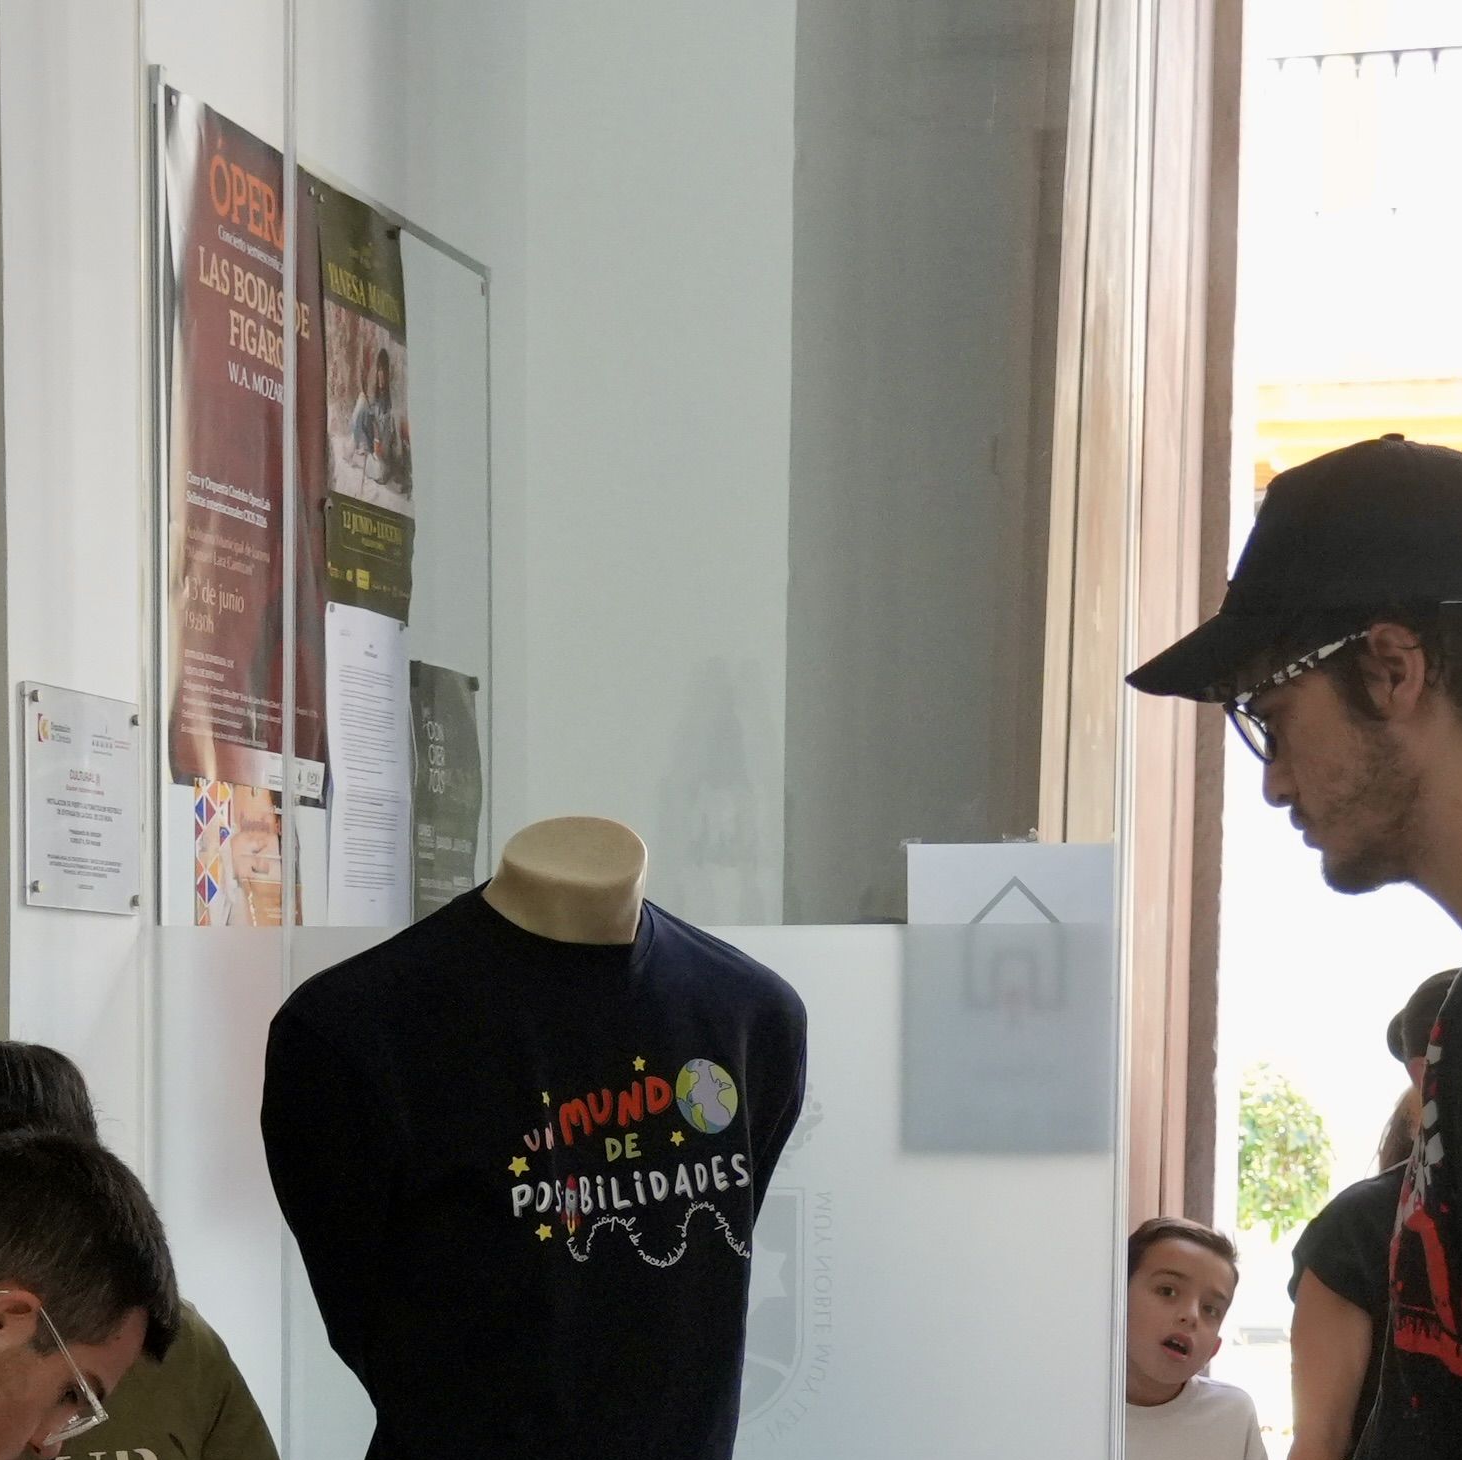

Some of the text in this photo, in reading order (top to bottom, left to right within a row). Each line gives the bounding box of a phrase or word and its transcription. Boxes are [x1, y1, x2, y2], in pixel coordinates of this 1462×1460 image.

[210, 138, 283, 249] ÓPER
[198, 245, 230, 297] LAS
[232, 263, 284, 328] BODAS
[252, 375, 284, 406] MOZAR
[201, 582, 217, 606] de
[218, 583, 245, 614] junio
[523, 1122, 555, 1152] UN
[605, 1132, 641, 1162] DE
[628, 1231, 643, 1247] de
